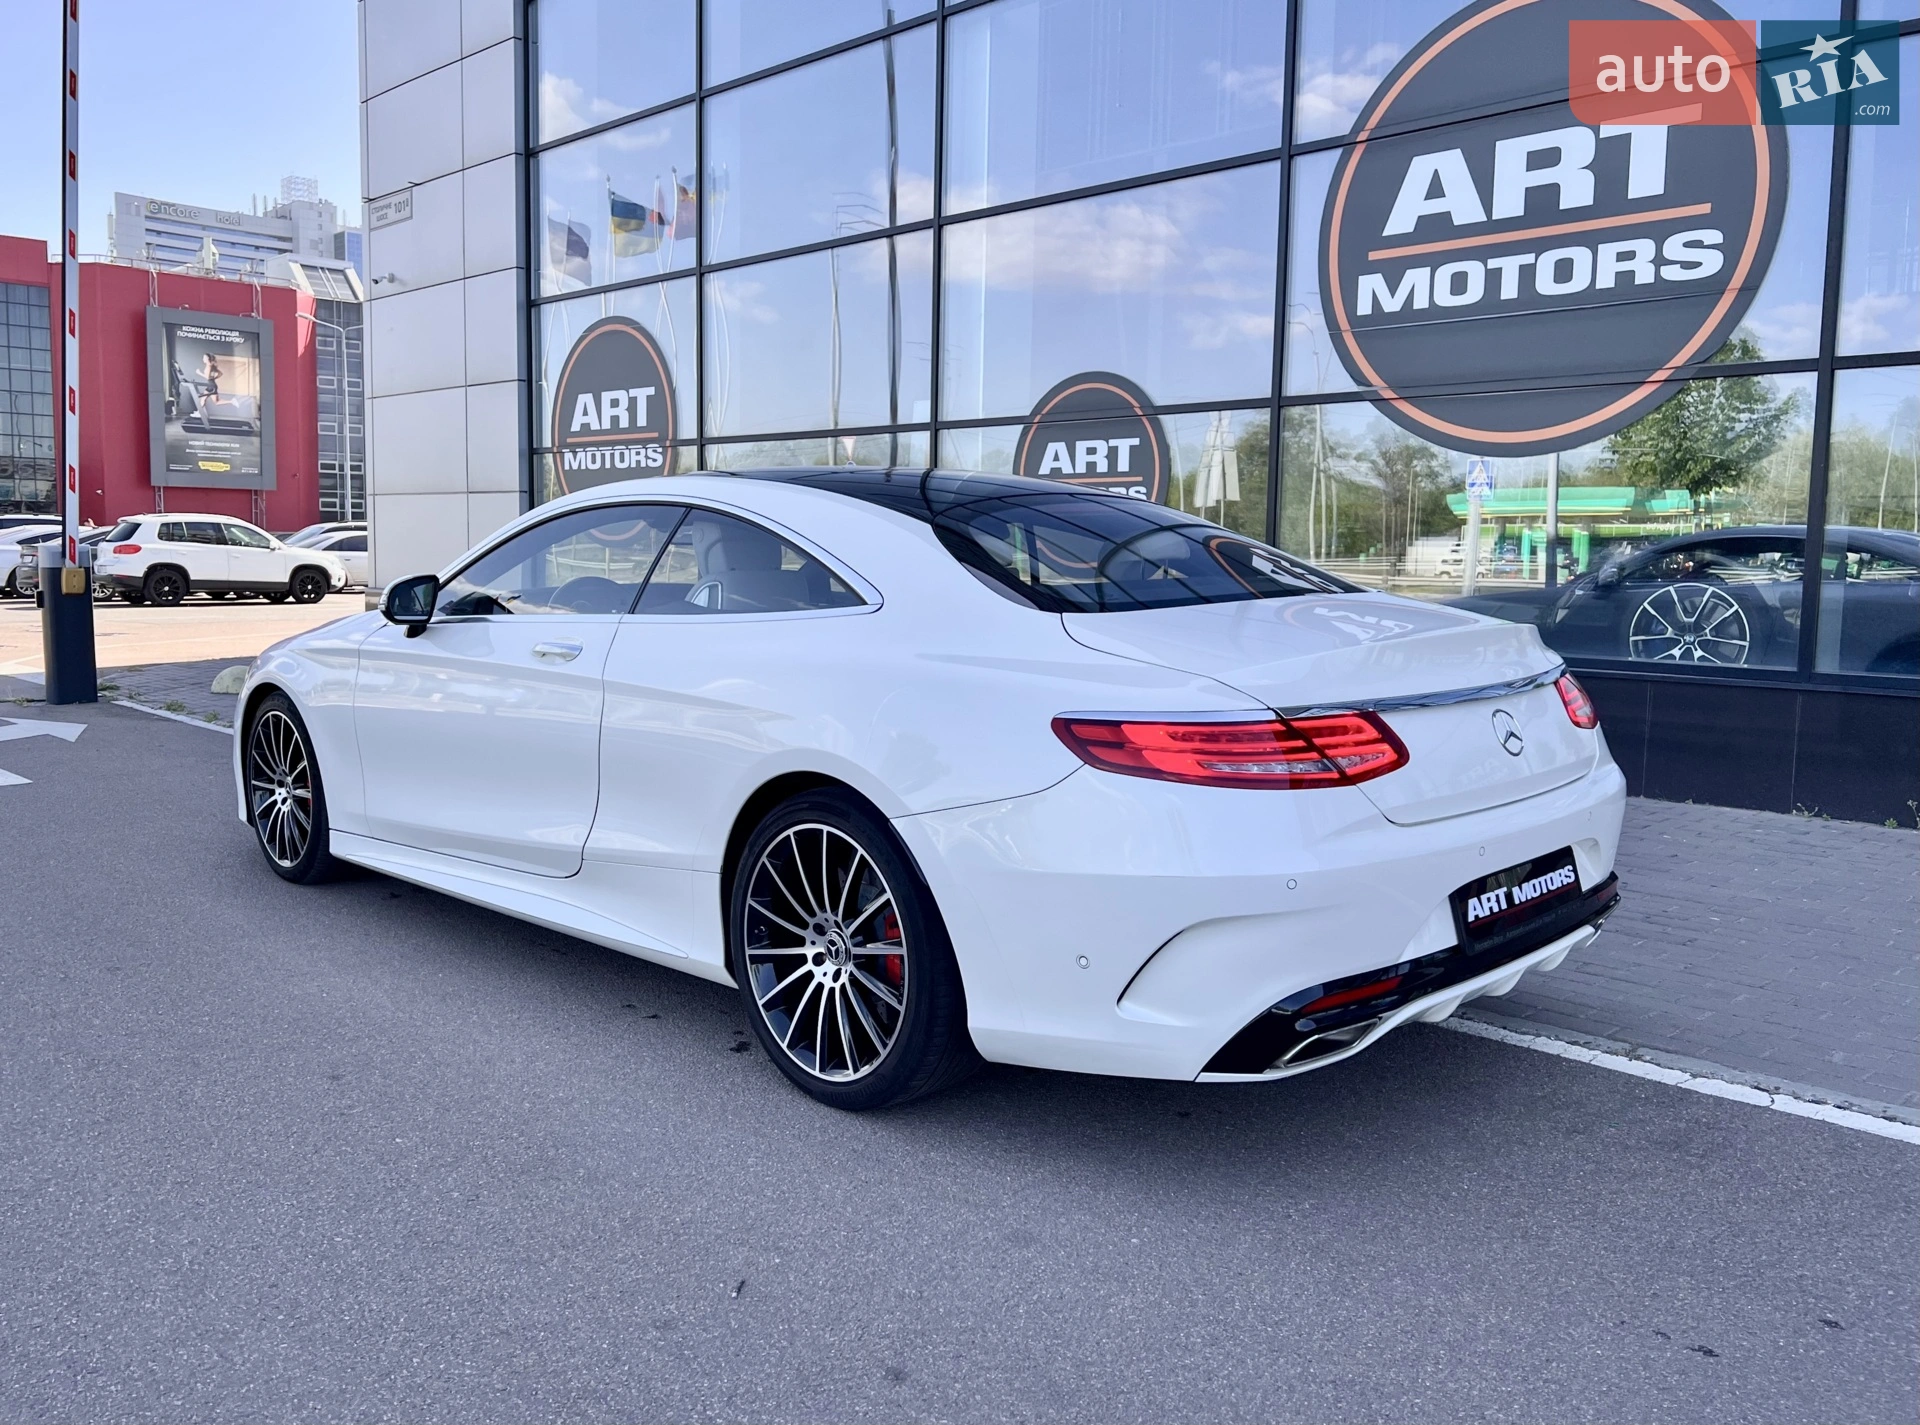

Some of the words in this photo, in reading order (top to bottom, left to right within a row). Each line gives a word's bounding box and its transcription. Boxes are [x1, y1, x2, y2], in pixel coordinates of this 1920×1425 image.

[1382, 102, 1703, 237] ART
[149, 201, 200, 219] encore
[1356, 228, 1725, 316] MOTORS
[182, 325, 204, 334] КОЖНА
[570, 386, 656, 432] ART
[562, 443, 664, 470] MOTORS
[1038, 437, 1140, 475] ART
[1467, 887, 1508, 922] ART
[1511, 865, 1576, 905] MOTORS
